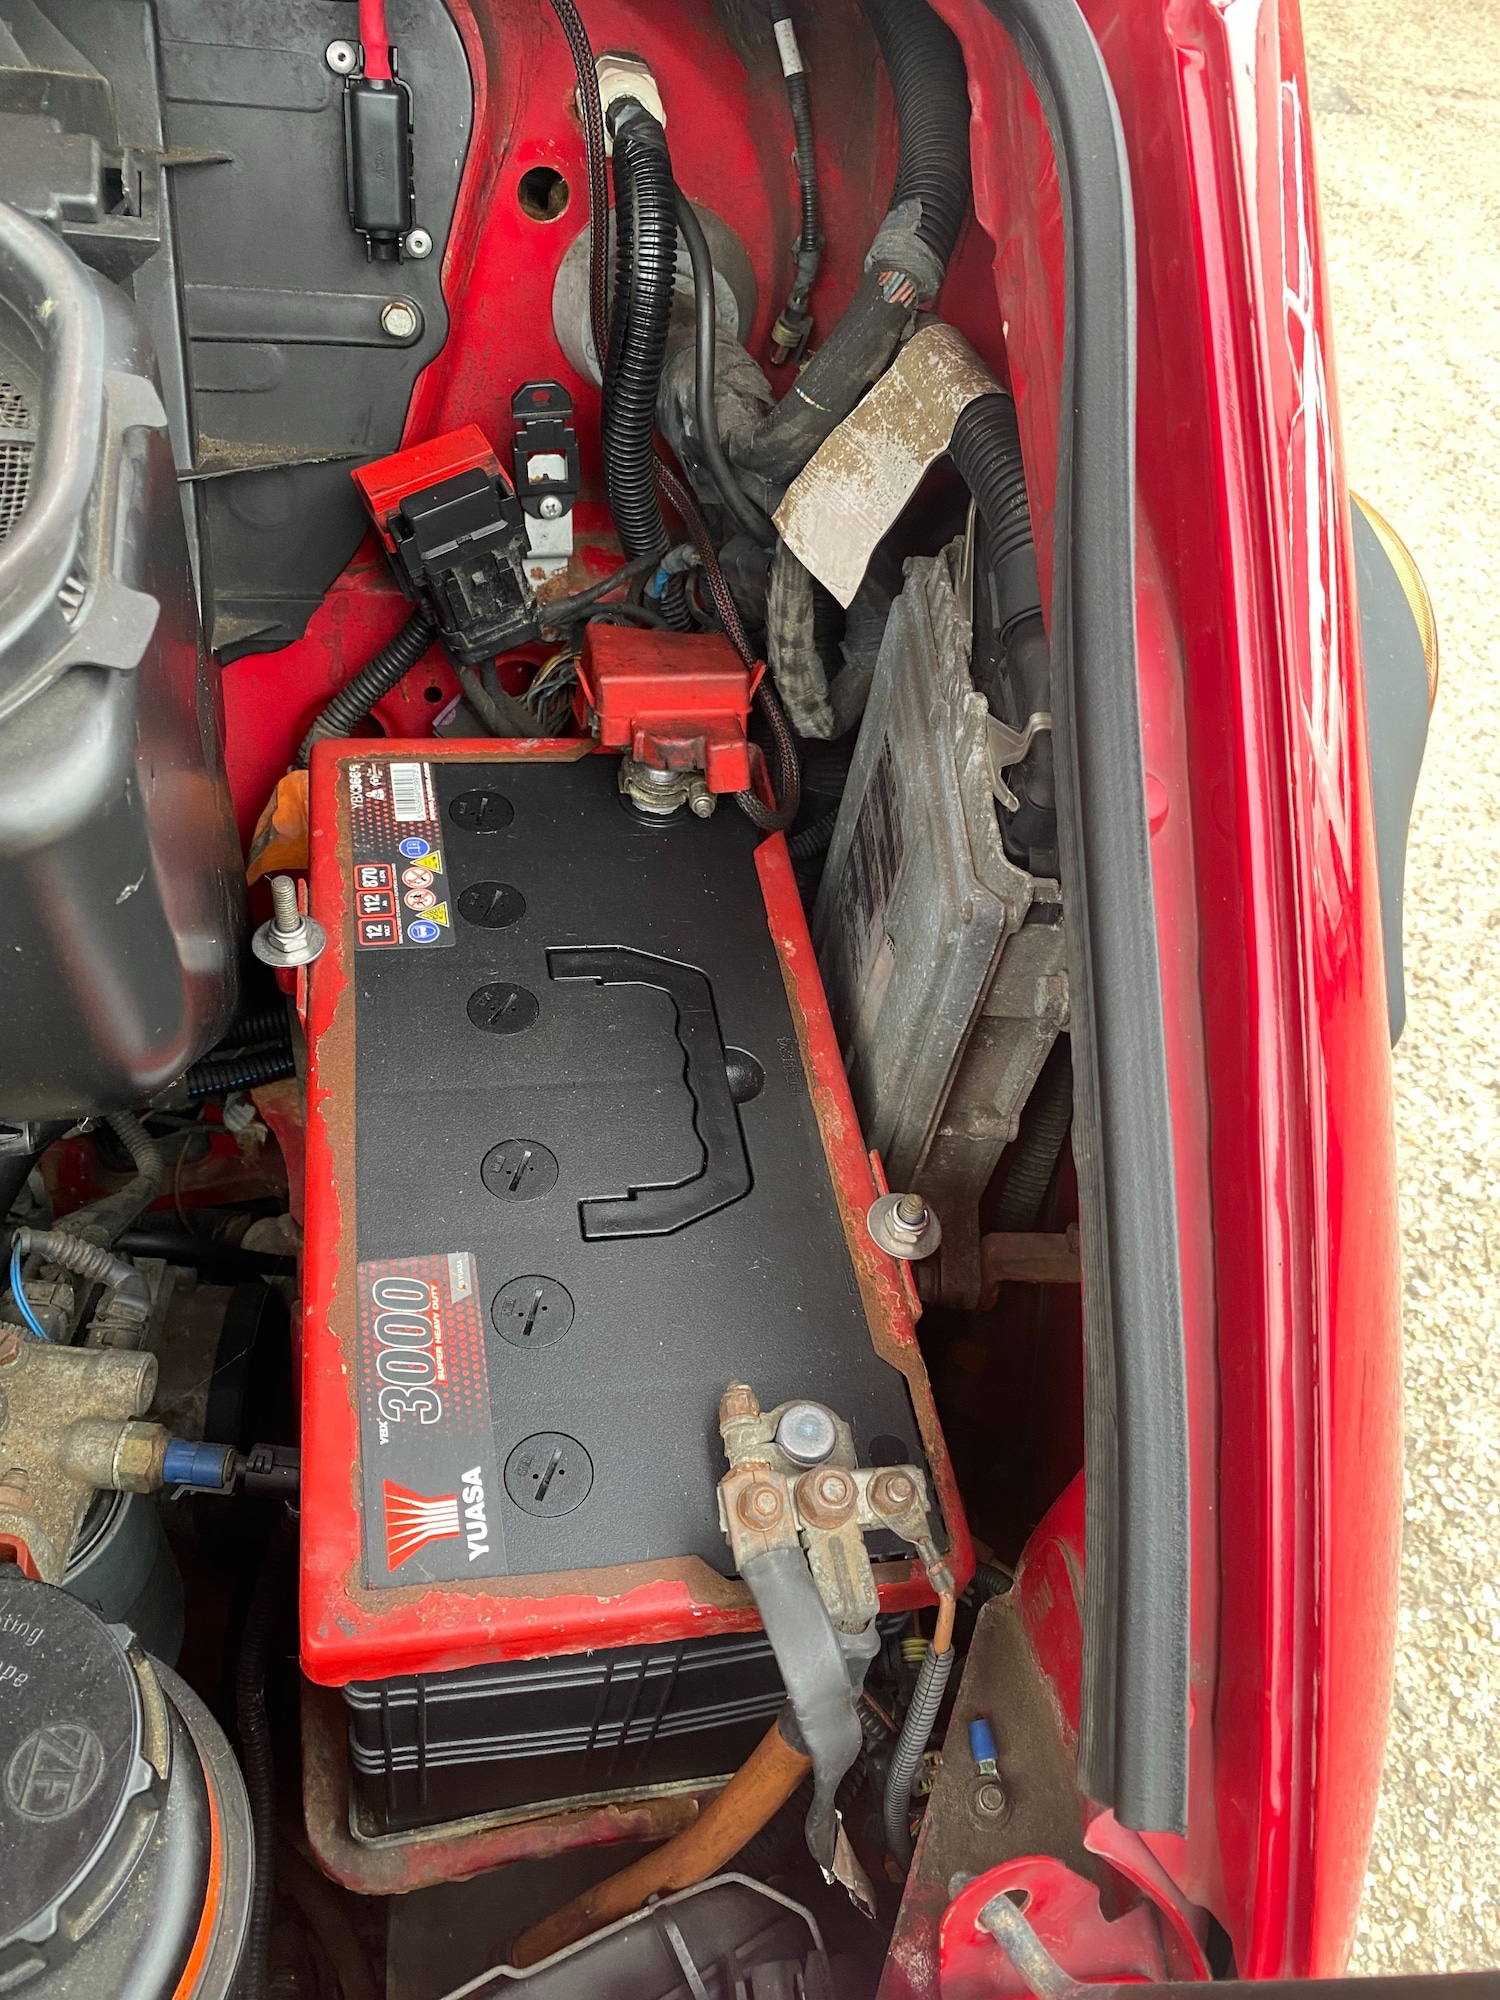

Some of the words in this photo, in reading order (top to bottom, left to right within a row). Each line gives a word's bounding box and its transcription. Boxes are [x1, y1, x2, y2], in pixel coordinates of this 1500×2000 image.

[361, 867, 378, 888] 870
[363, 894, 381, 914] 112
[365, 924, 382, 939] 12
[430, 1285, 441, 1310] DUTY
[432, 1312, 443, 1344] HEAVY
[373, 1277, 442, 1424] 3000
[435, 1346, 446, 1381] SUPER
[461, 1466, 490, 1562] YUASA
